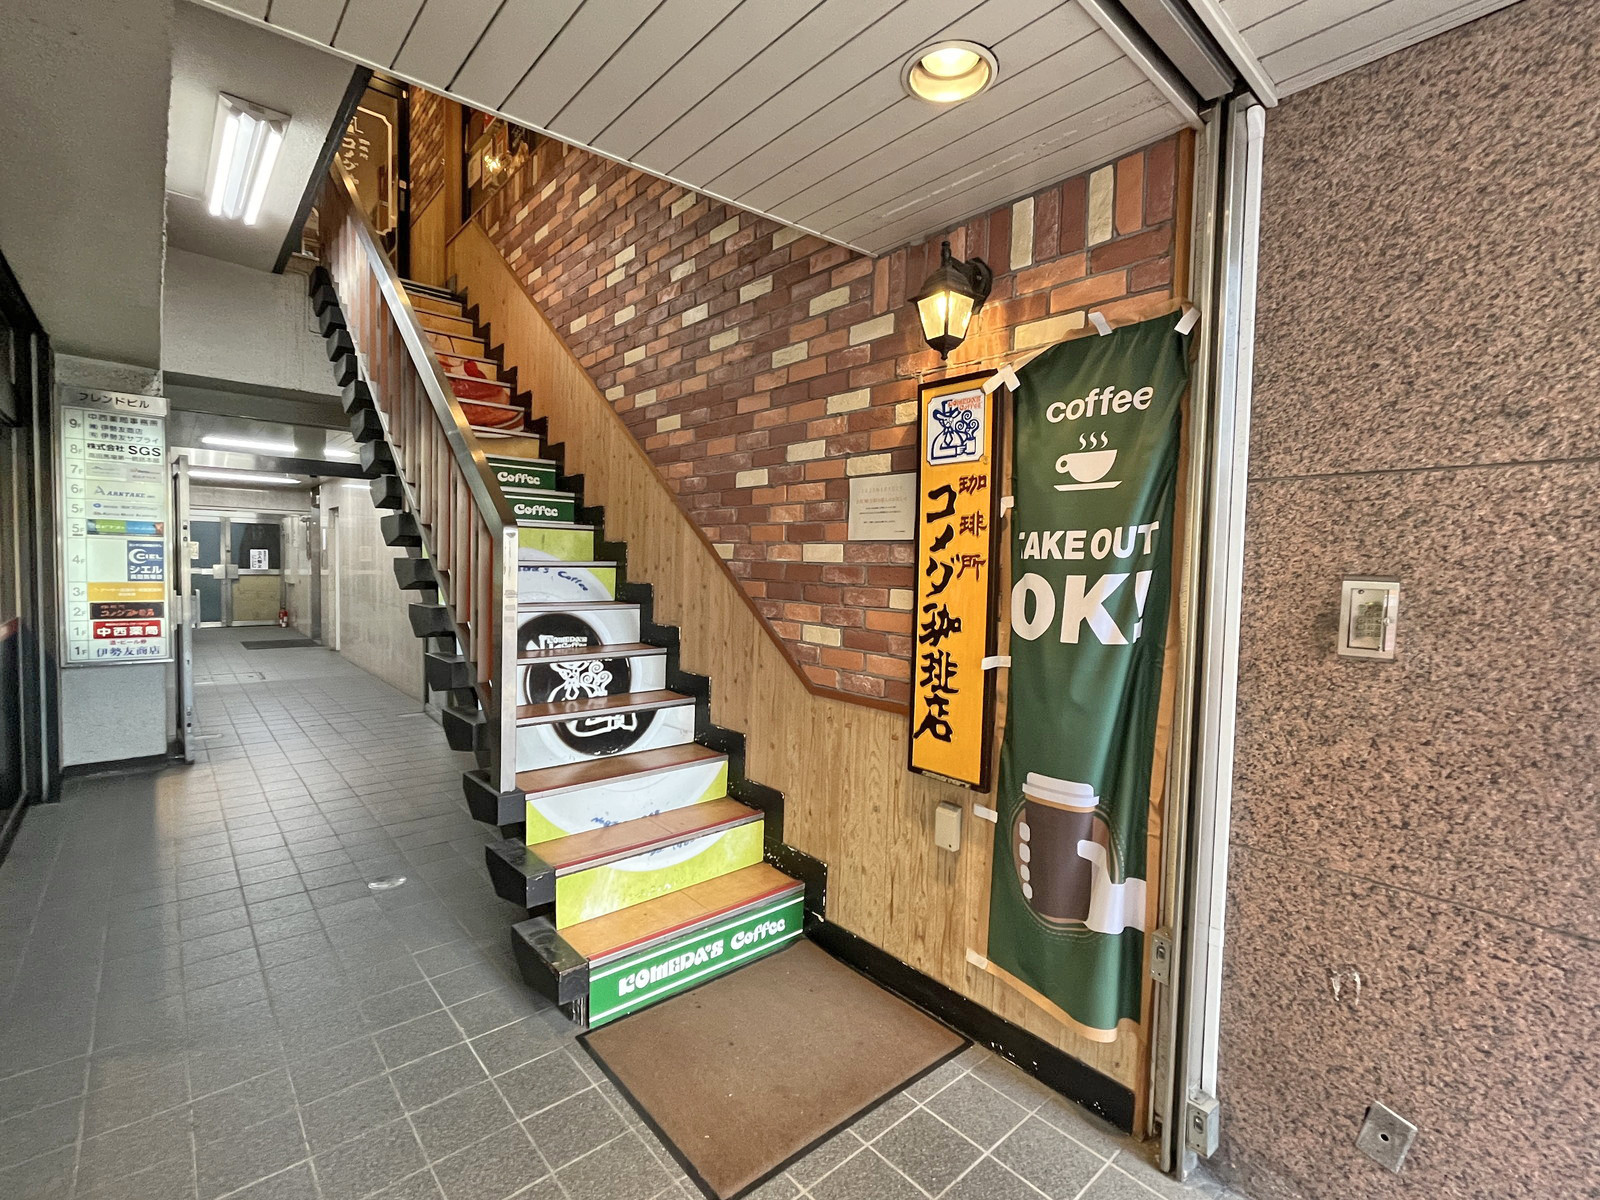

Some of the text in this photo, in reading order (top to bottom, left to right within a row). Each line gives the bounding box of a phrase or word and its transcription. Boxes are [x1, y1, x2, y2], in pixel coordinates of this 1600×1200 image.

[78, 391, 150, 409] フレンドビル
[1046, 386, 1154, 423] coffee
[69, 418, 81, 428] 9F
[70, 444, 82, 453] 8F
[87, 443, 161, 457] 株式会社 SGS
[70, 464, 83, 474] 7F
[497, 471, 541, 485] Coffee
[71, 484, 83, 493] 6F
[71, 504, 83, 513] 5F
[513, 503, 559, 517] Coffee
[72, 524, 84, 533] 5F
[957, 474, 987, 582] 珈琲所
[1090, 520, 1160, 560] OUT
[72, 555, 85, 564] 4F
[129, 566, 163, 574] シエル
[72, 587, 85, 597] 3F
[73, 607, 86, 617] 2F
[1011, 570, 1153, 645] OK!
[913, 484, 961, 743] コメダ珈琲店
[96, 626, 158, 637] 中西薬局
[74, 646, 87, 656] 1F
[618, 918, 786, 997] KOMEDA'S Coffee
